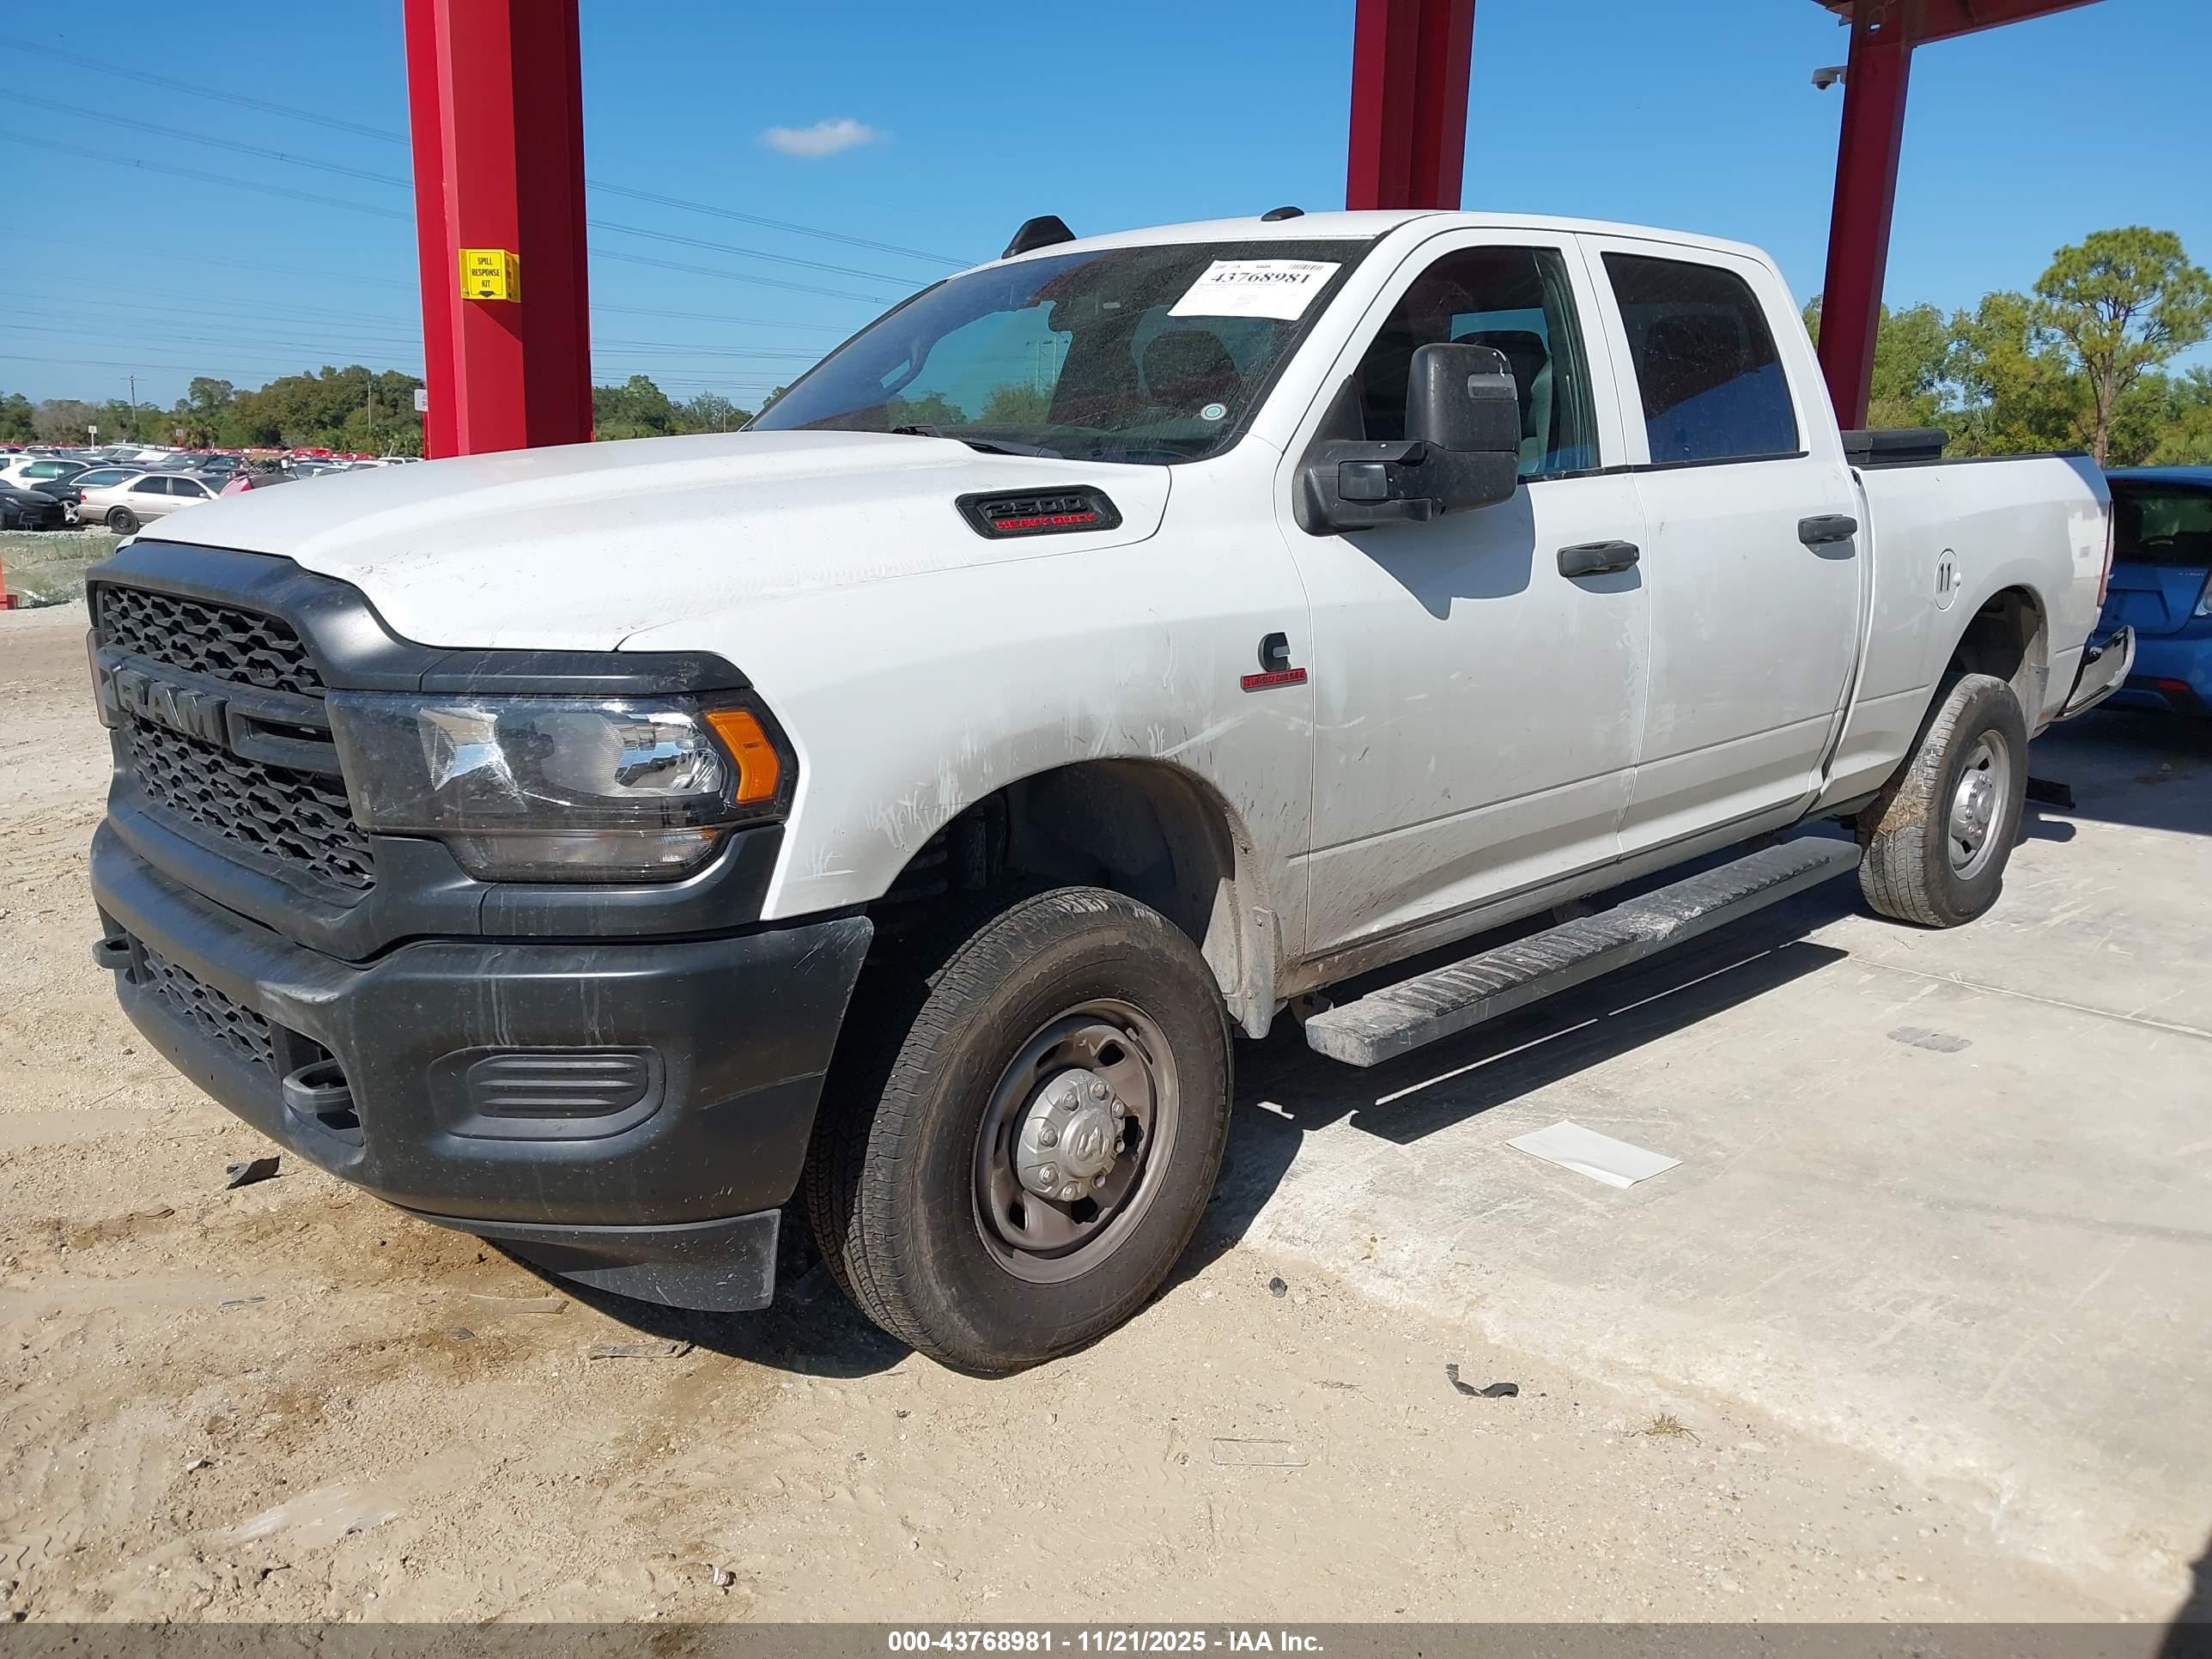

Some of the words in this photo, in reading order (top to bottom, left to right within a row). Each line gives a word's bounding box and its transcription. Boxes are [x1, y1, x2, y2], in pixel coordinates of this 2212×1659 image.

[477, 257, 493, 265] SPILL
[471, 268, 501, 276] RESPONSE
[1211, 272, 1311, 284] 43768981
[481, 279, 490, 288] KIT
[984, 497, 1087, 519] 2500
[995, 517, 1050, 530] HEAVY
[1052, 513, 1096, 526] DUTY
[1939, 562, 1952, 592] 11
[1243, 674, 1273, 688] TURBO
[1276, 669, 1306, 684] DIESEL
[116, 672, 223, 744] RAM
